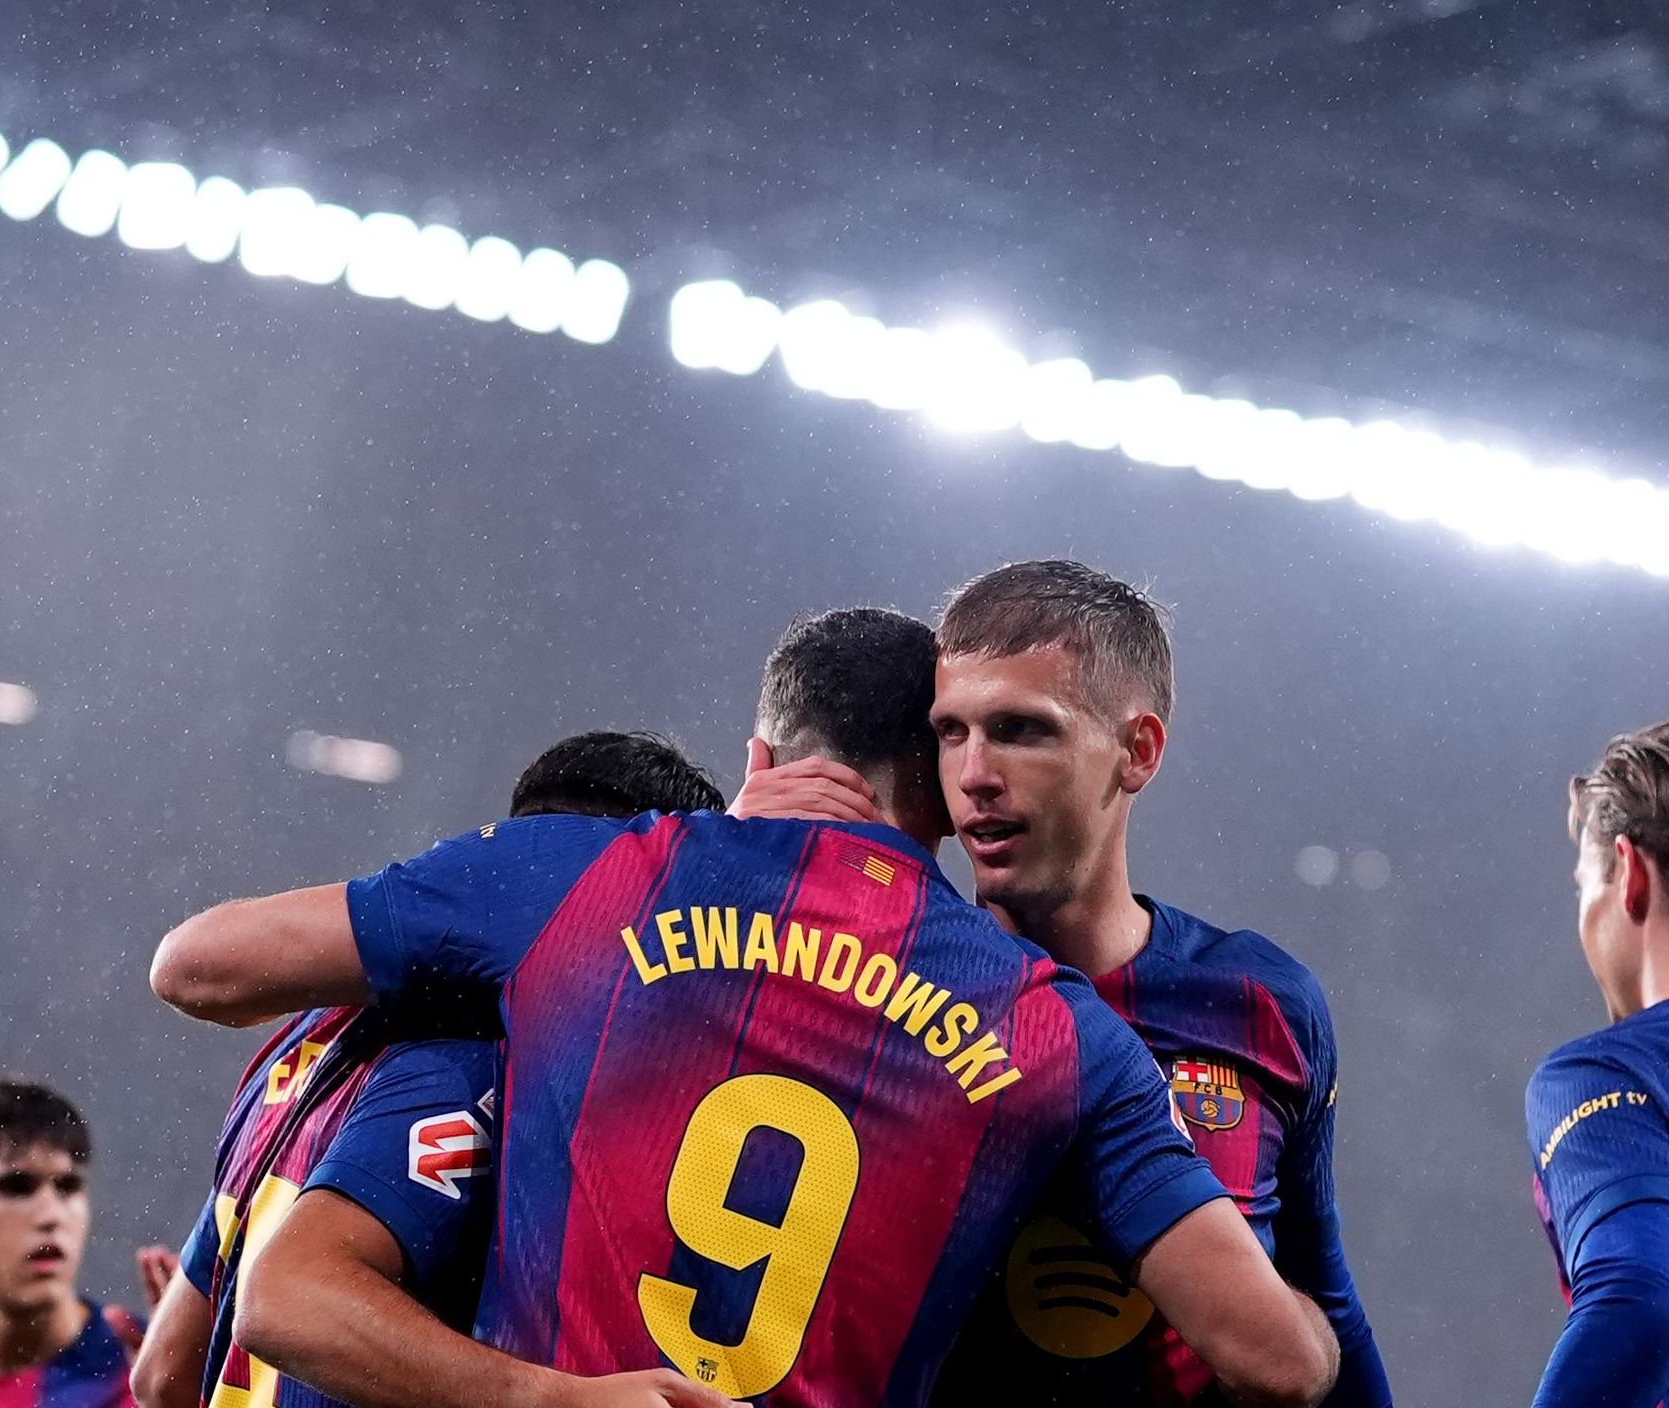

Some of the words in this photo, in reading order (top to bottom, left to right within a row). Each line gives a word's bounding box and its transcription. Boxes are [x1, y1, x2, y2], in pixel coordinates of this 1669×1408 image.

[620, 905, 1023, 1104] LEWANDOWSKI
[1626, 1090, 1647, 1105] tv
[636, 1073, 860, 1400] 9
